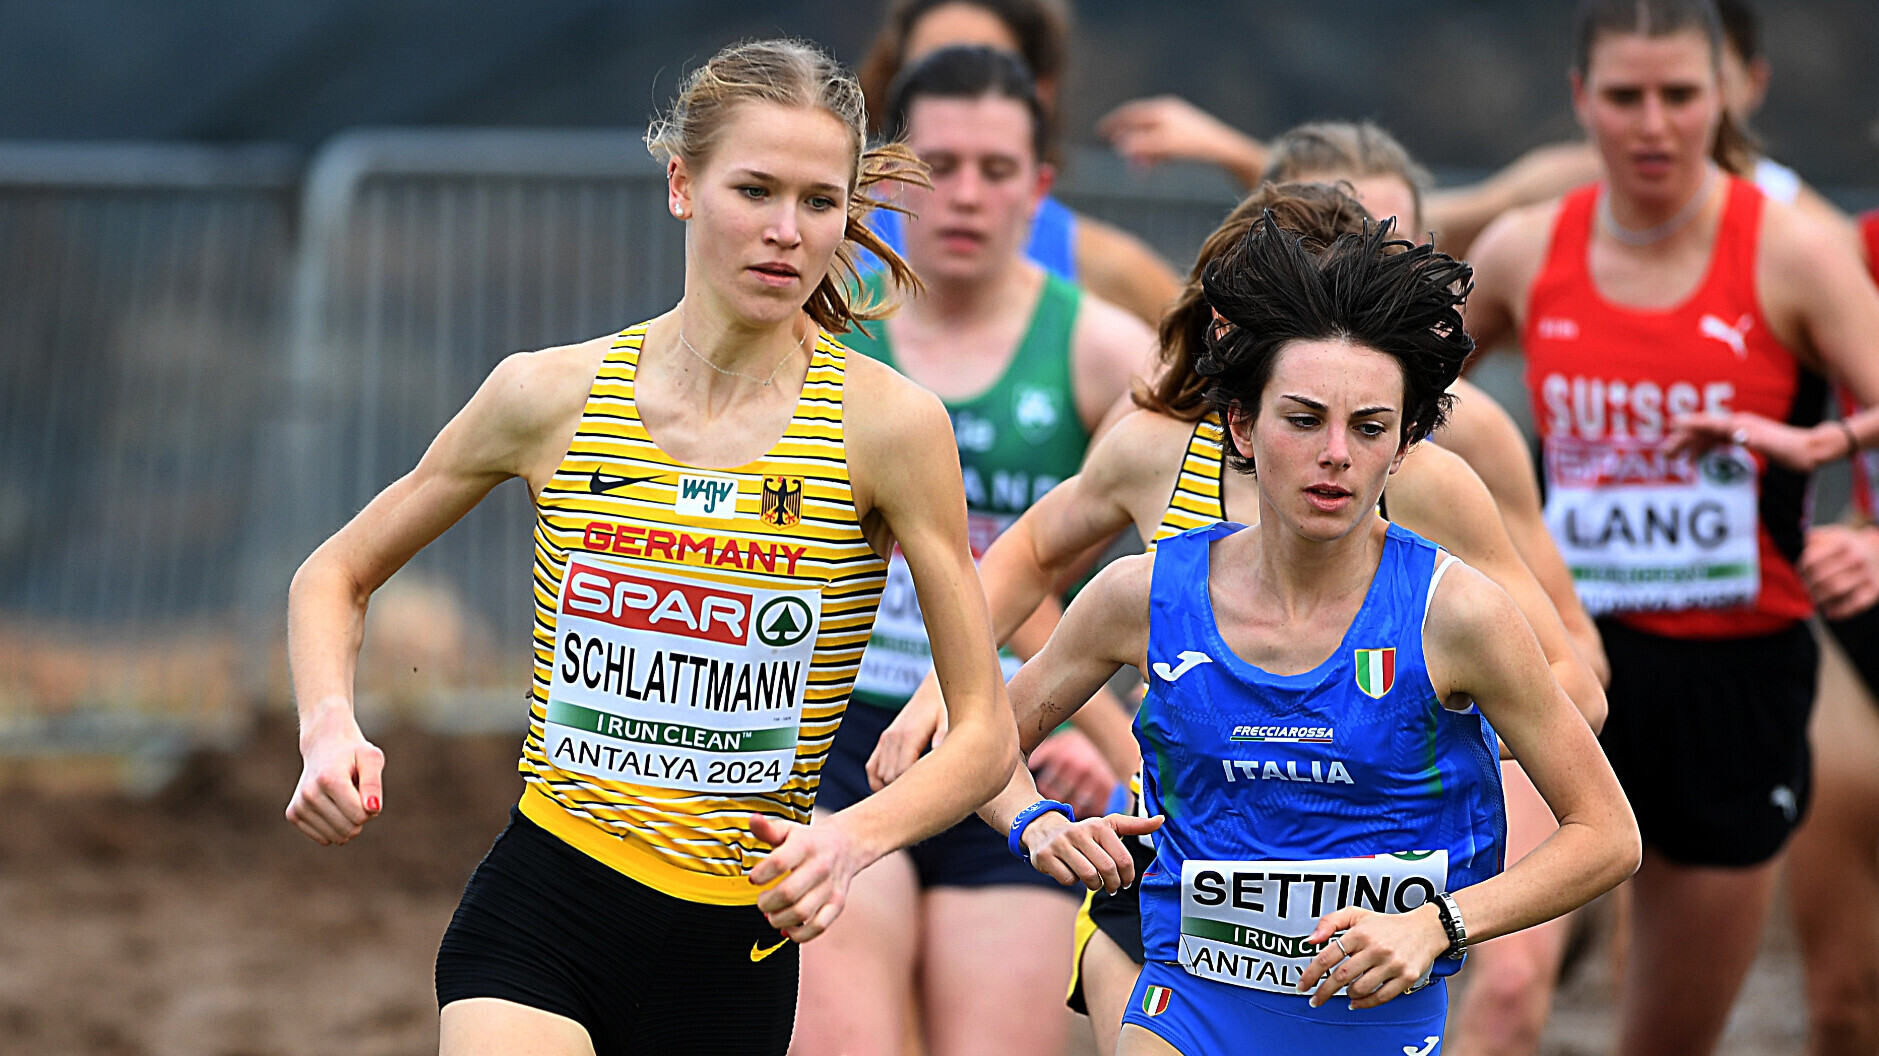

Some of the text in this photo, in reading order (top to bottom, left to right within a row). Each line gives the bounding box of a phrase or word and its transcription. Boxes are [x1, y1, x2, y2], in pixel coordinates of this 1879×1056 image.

[582, 521, 807, 576] GERMANY
[1565, 499, 1729, 551] LANG
[567, 571, 747, 639] SPAR
[561, 631, 801, 713] SCHLATTMANN
[596, 713, 604, 731] I
[608, 716, 659, 742] RUN
[1232, 725, 1334, 738] FRECCIAROSSA
[554, 737, 782, 784] ANTALYA 2024
[1222, 759, 1355, 785] ITALIA
[1192, 870, 1435, 919] SETTINO
[1233, 926, 1240, 943] I
[1245, 929, 1293, 955] RUN
[1194, 947, 1350, 988] ANTAL
